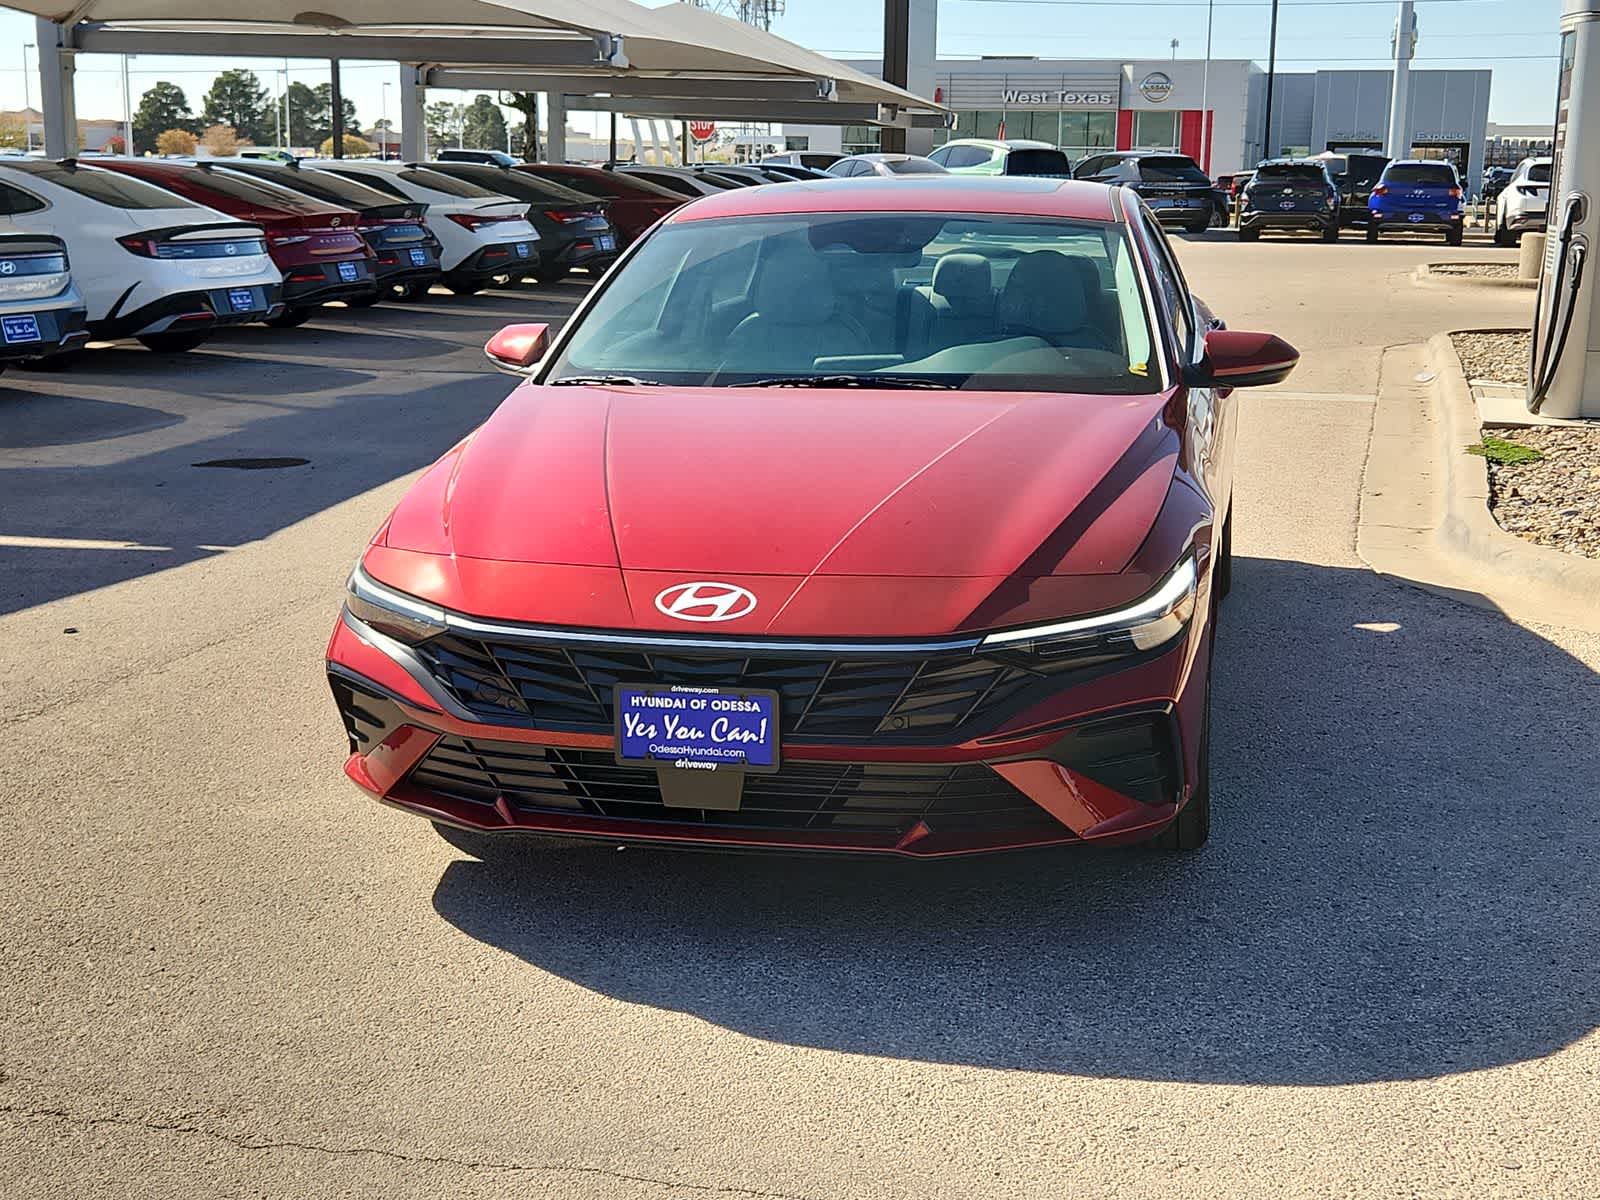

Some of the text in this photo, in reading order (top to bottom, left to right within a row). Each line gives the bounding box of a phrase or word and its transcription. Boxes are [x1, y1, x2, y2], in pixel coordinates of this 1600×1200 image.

[1001, 90, 1113, 105] West Texas
[671, 685, 719, 695] driveway.com
[631, 696, 761, 713] HYUNDAI OF ODESSA
[624, 712, 768, 744] Yes You Can!
[649, 743, 745, 758] OdessaHyundai.com
[675, 758, 718, 771] driveway
